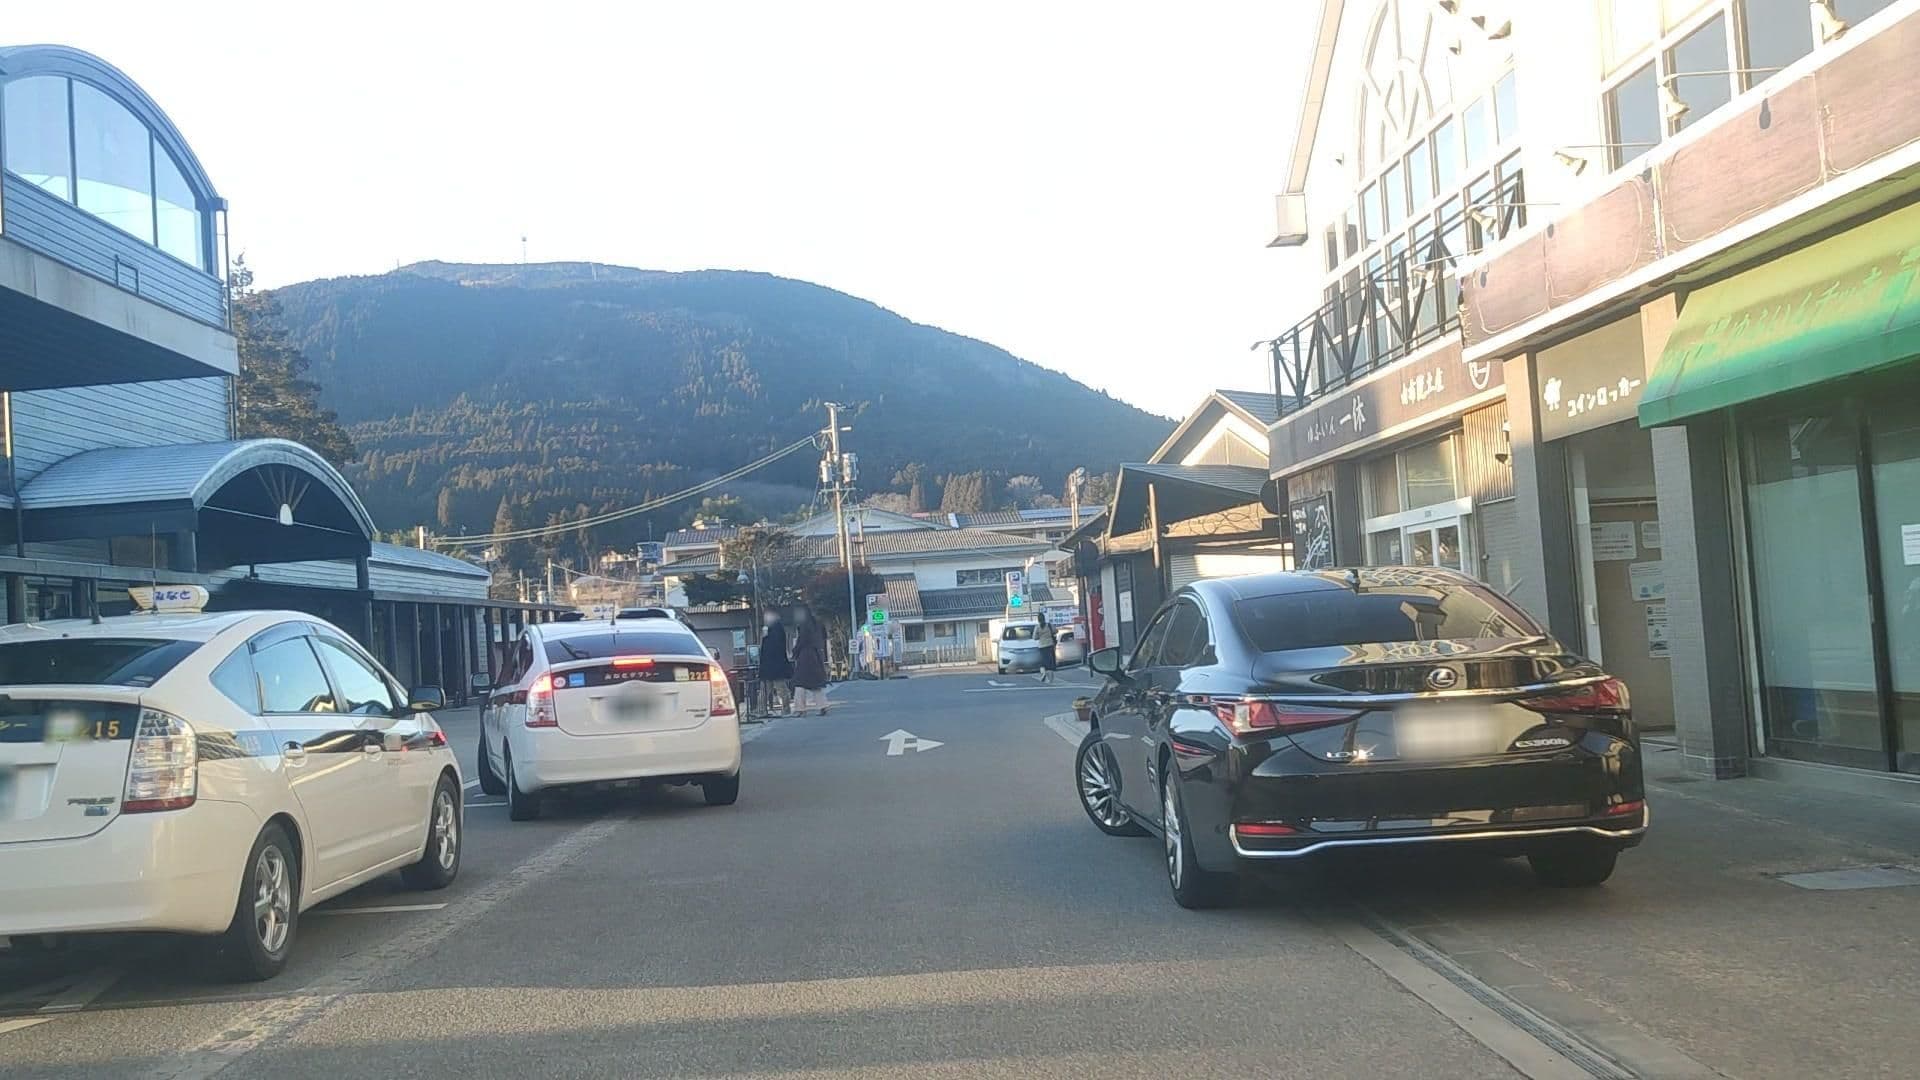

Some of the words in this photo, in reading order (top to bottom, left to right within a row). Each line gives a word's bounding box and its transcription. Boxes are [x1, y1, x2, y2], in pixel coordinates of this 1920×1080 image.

[1568, 376, 1641, 418] コインロッカー
[1307, 395, 1366, 443] ゆふいん一休
[155, 590, 190, 601] みなと
[604, 671, 660, 680] みなとタクシー
